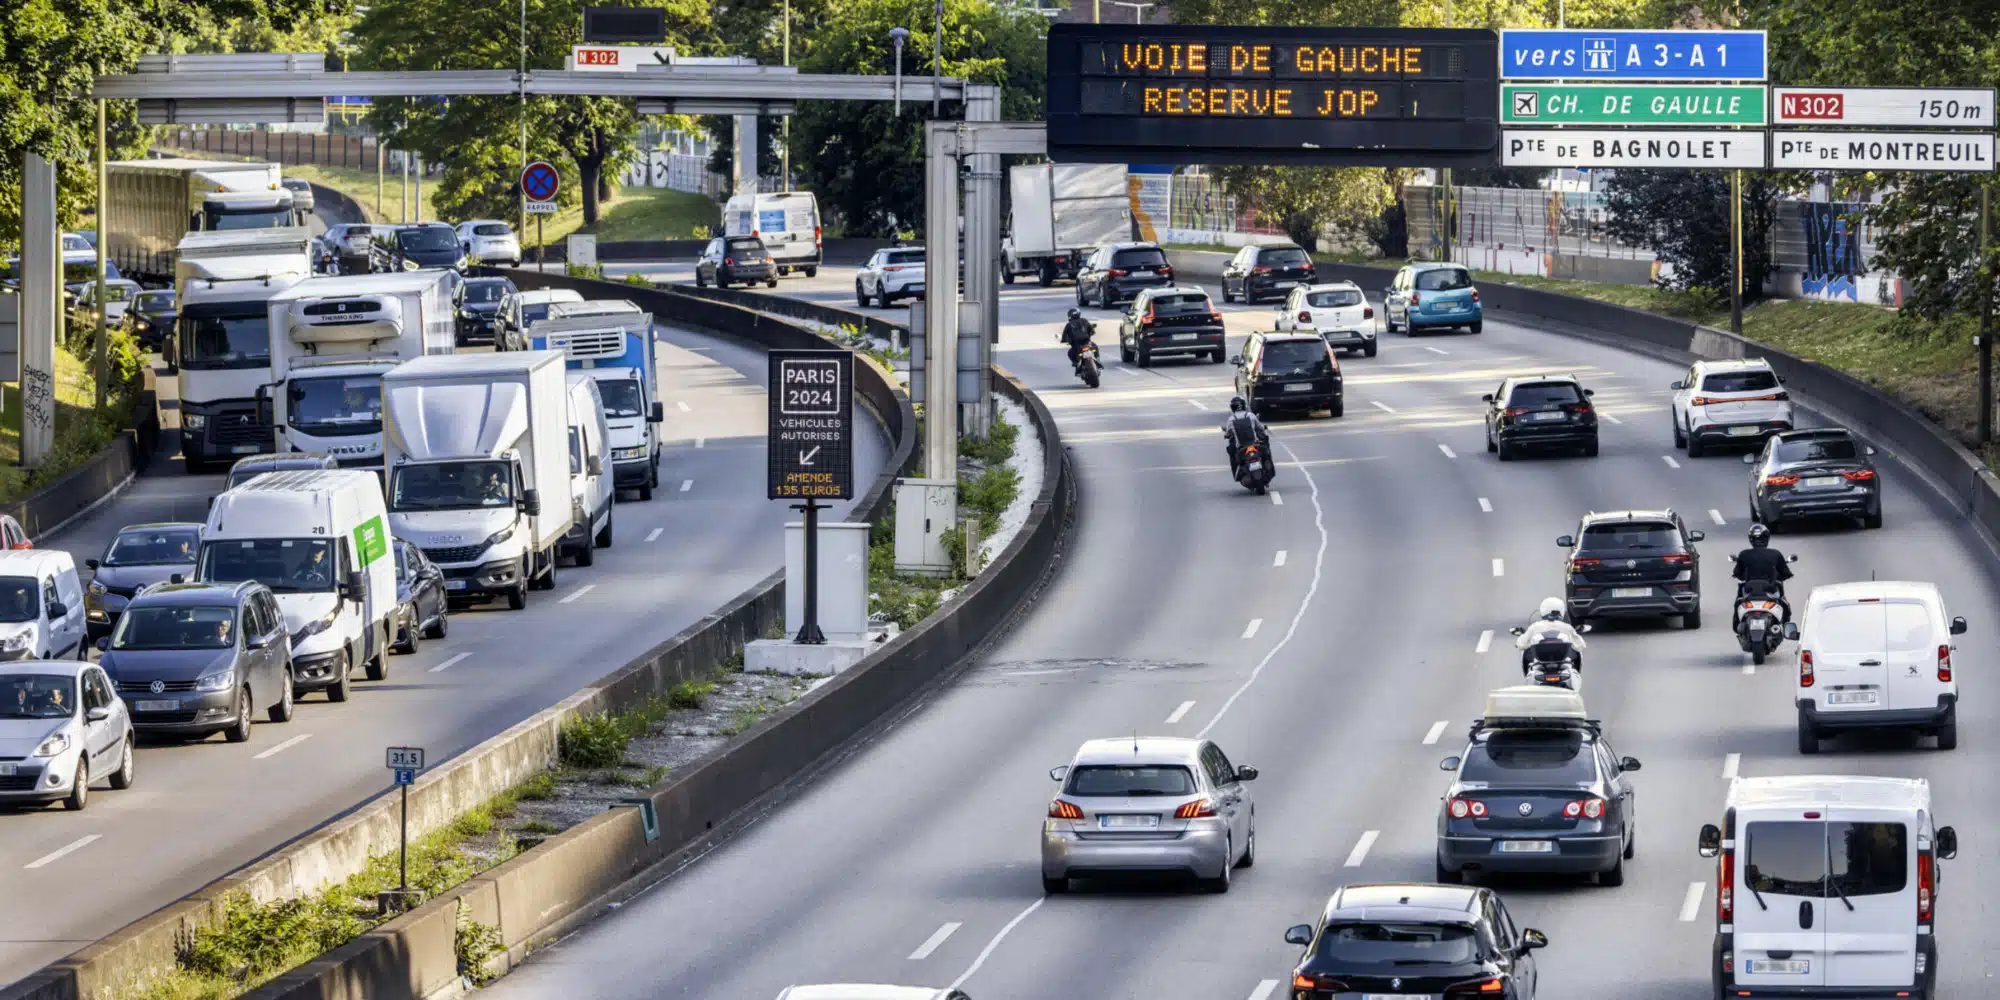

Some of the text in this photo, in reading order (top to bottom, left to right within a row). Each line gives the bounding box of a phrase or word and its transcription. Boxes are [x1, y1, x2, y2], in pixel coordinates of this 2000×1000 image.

[1122, 43, 1422, 74] VOIE DE GAUCHE
[1514, 48, 1576, 66] vers
[1144, 87, 1379, 116] RESERVE JOP
[1546, 94, 1741, 115] CH. DE GAULLE
[1557, 145, 1578, 157] DE
[1593, 140, 1731, 159] BAGNOLET
[1820, 147, 1839, 159] DE
[1848, 142, 1985, 161] MONTREUIL
[786, 369, 836, 384] PARIS
[789, 390, 833, 405] 2024
[780, 418, 841, 428] VEHICULES
[781, 431, 840, 441] AUTORISES
[786, 472, 833, 483] AMENDE
[777, 485, 841, 495] 135 EUROS
[312, 526, 325, 535] 20
[392, 752, 418, 764] 31.5
[400, 771, 409, 783] E
